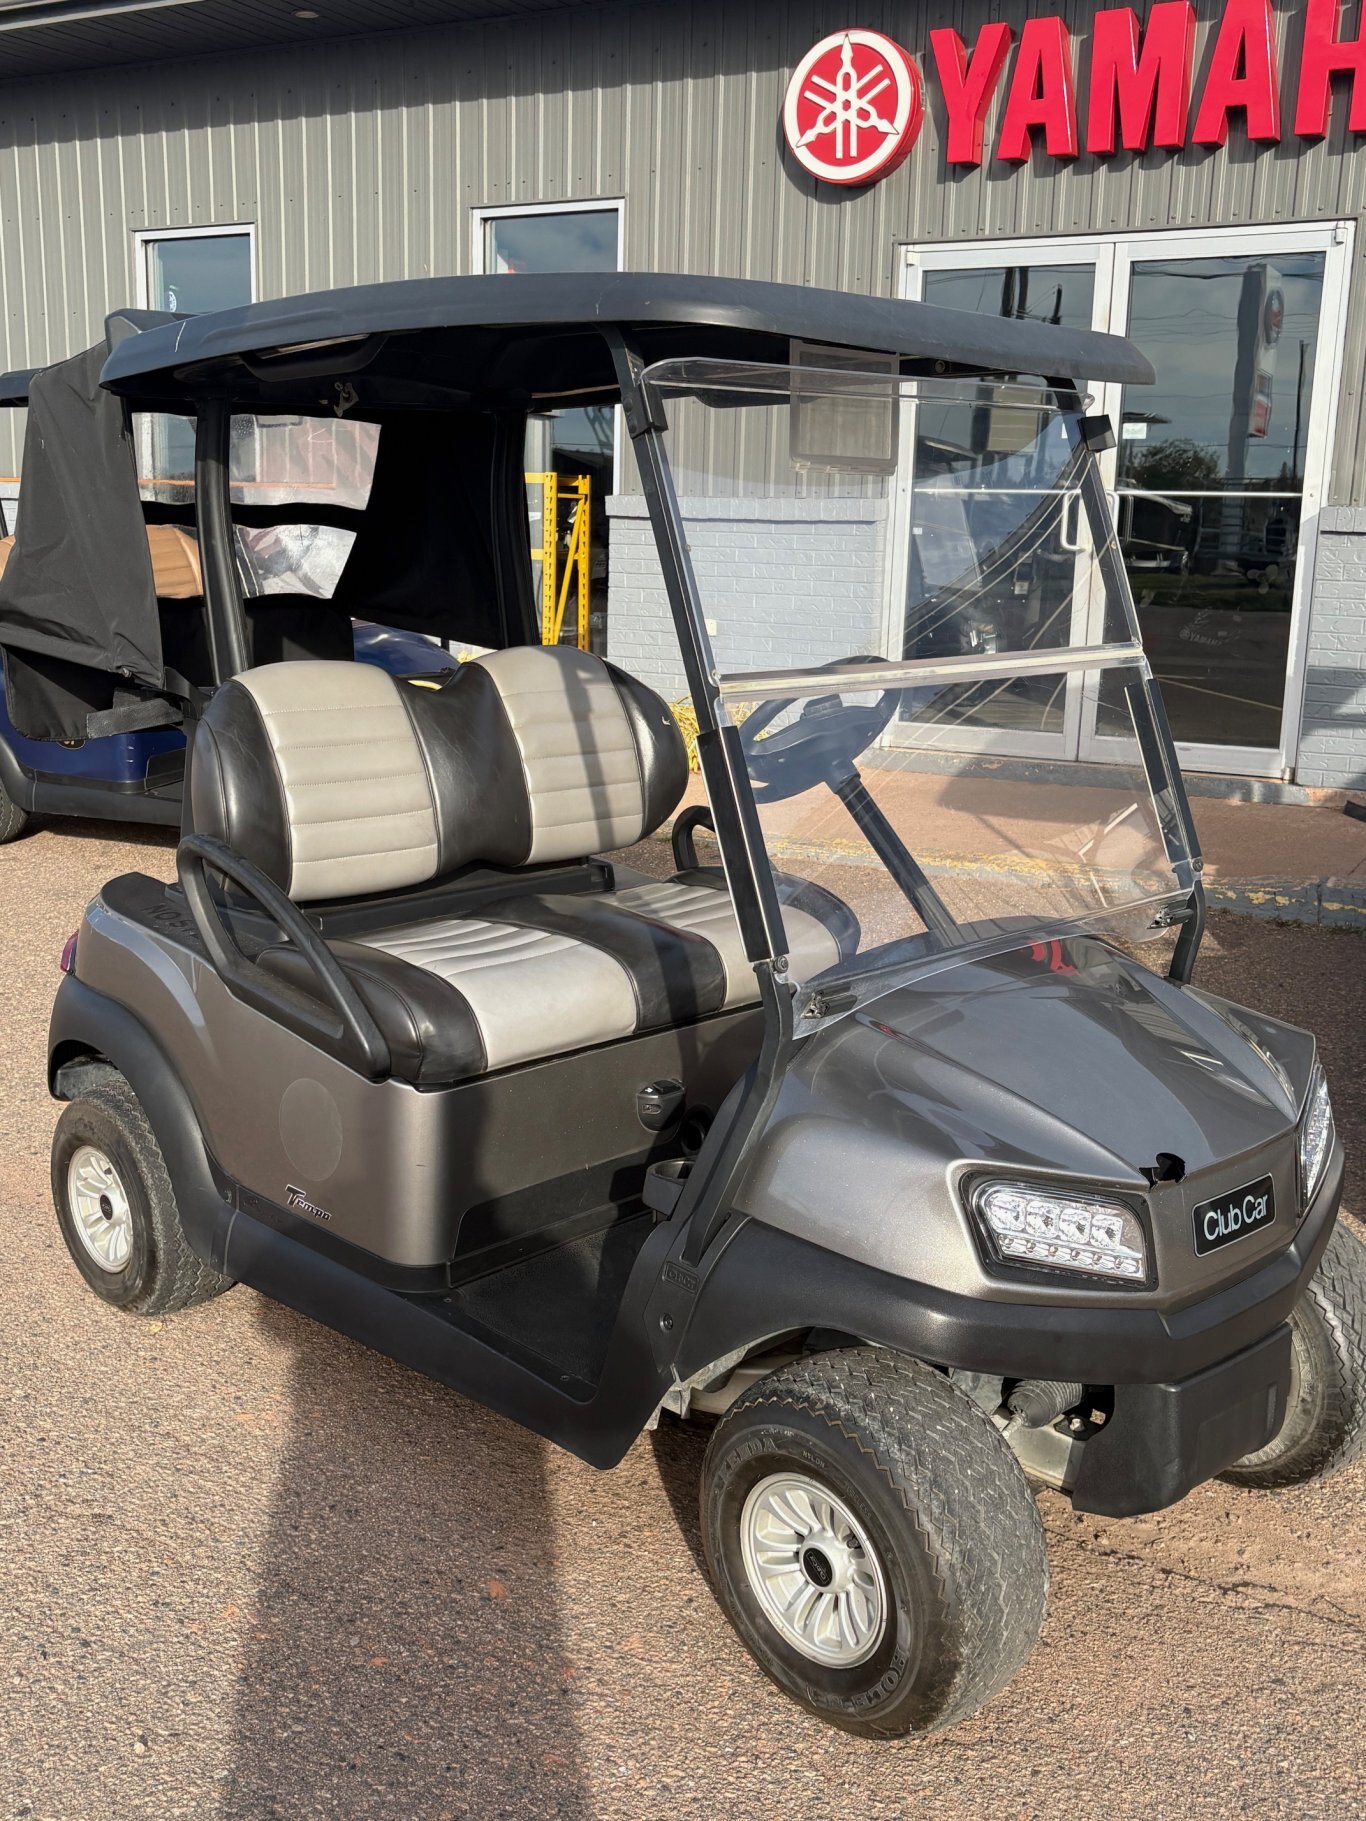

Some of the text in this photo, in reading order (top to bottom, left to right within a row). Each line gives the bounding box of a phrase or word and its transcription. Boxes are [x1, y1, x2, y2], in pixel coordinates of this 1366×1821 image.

[930, 0, 1366, 166] YAMAH
[285, 1184, 332, 1221] Tempo
[1203, 1194, 1268, 1241] Club Car
